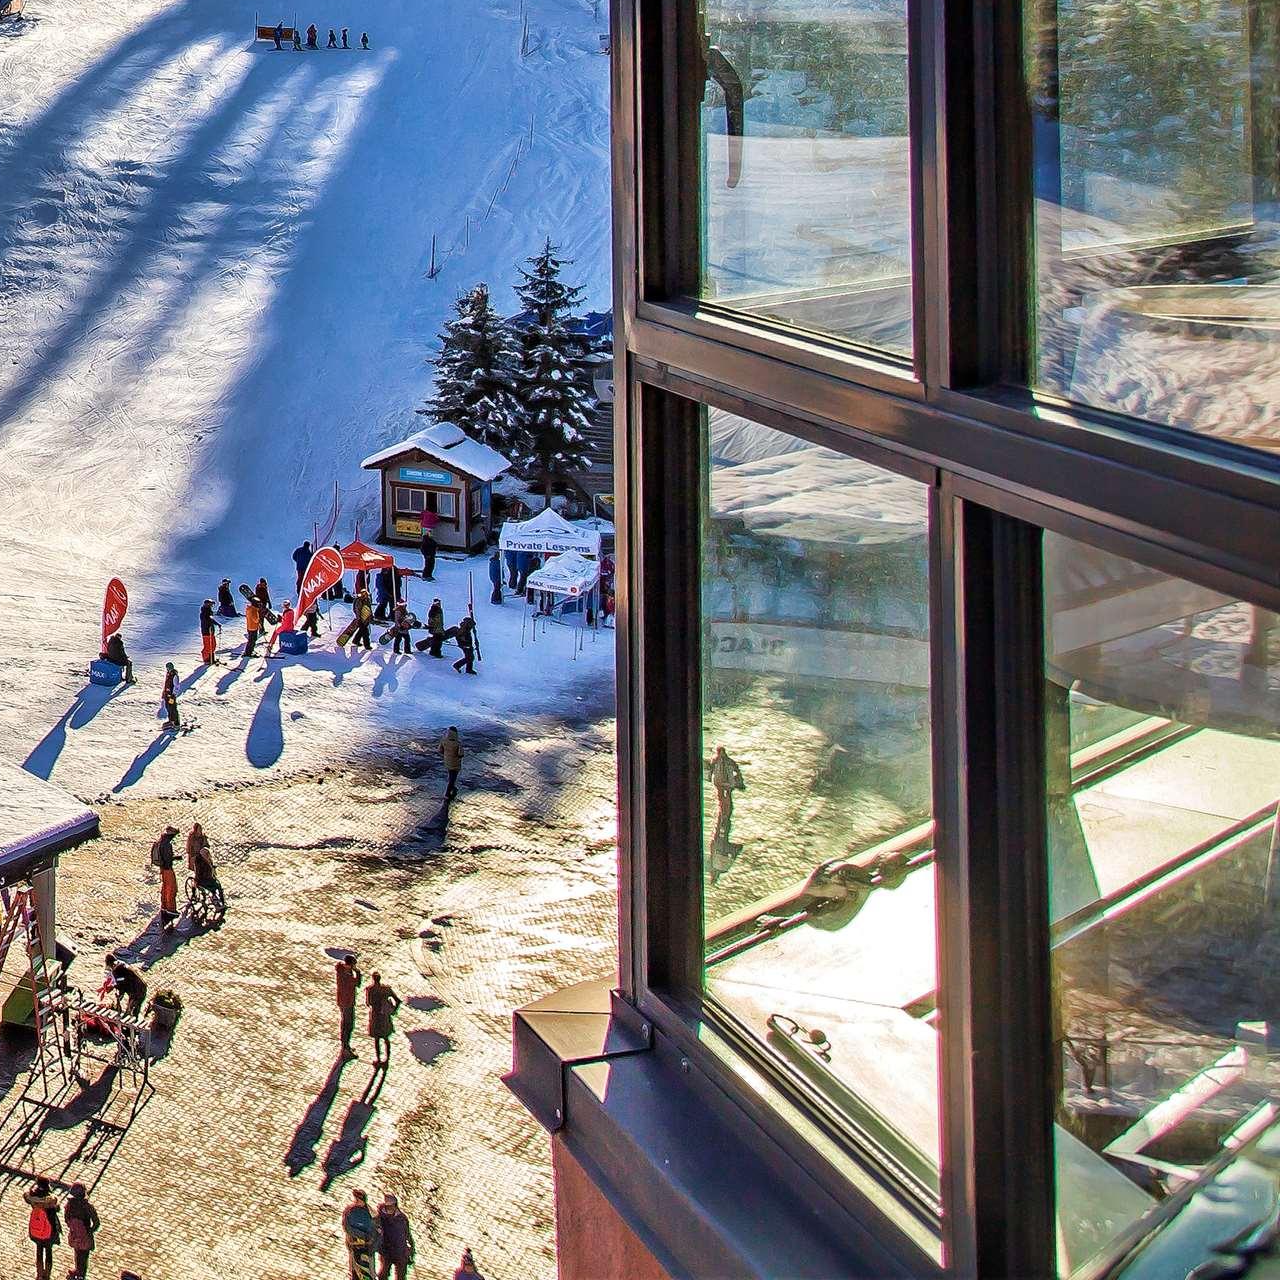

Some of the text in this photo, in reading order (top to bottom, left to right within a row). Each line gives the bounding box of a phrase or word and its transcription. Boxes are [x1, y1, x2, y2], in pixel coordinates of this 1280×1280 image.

[506, 540, 591, 553] Private Lessons
[303, 572, 325, 598] MAX
